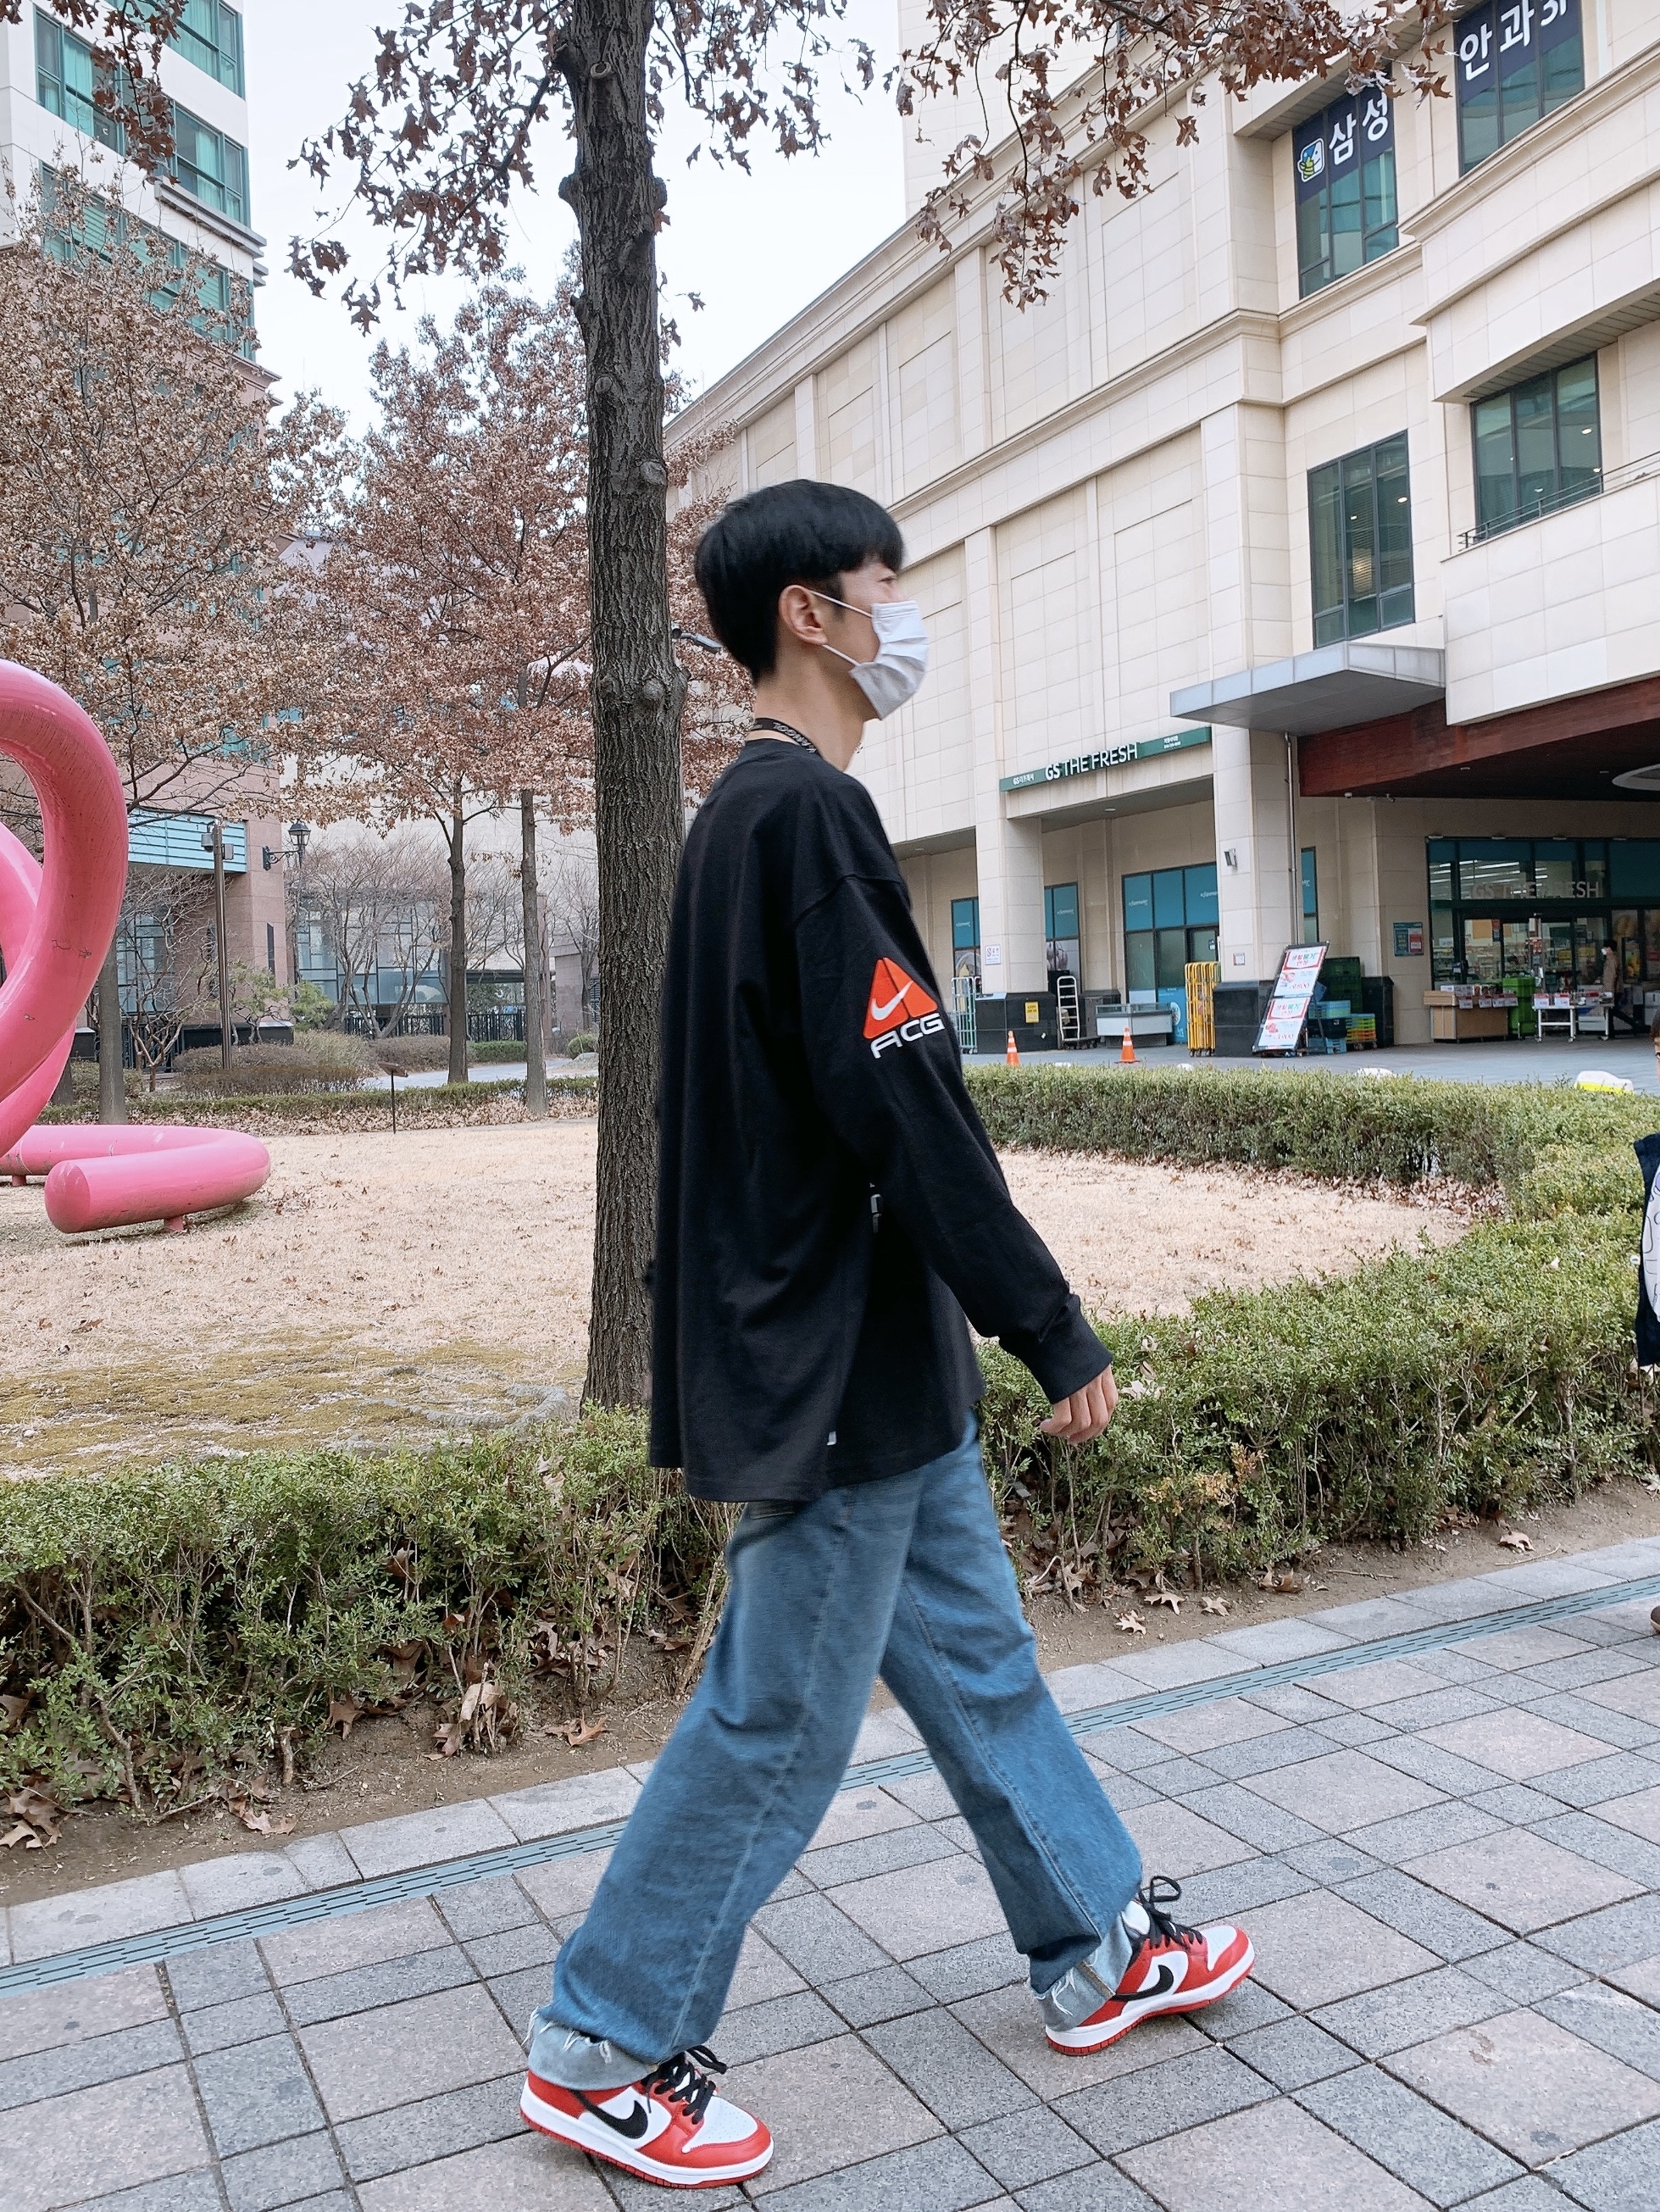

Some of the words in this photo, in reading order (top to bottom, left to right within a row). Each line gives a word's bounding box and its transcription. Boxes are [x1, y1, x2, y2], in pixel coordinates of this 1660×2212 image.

[1329, 92, 1389, 166] 삼성
[773, 722, 817, 753] KANGOL
[1045, 762, 1060, 781] GS
[1061, 754, 1089, 776] THE
[1091, 742, 1138, 770] FRESH
[870, 1013, 945, 1059] ACG
